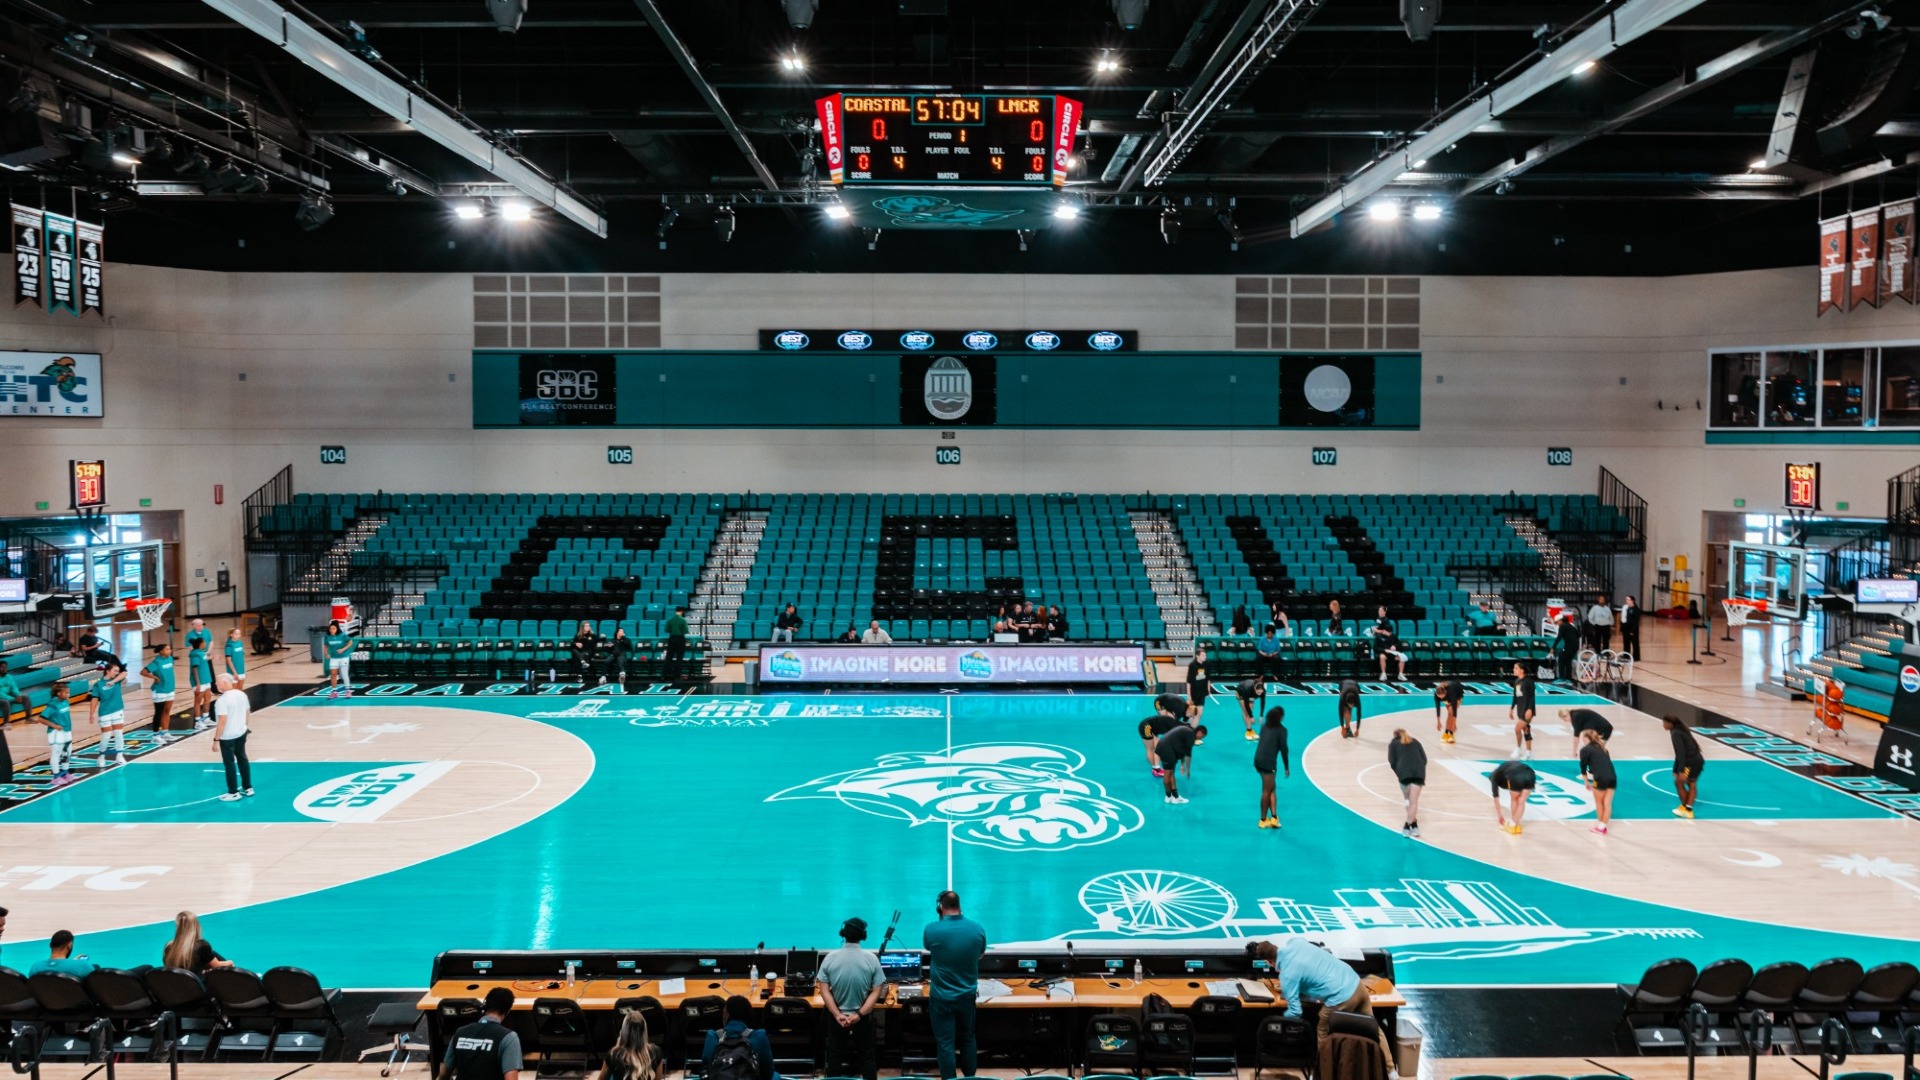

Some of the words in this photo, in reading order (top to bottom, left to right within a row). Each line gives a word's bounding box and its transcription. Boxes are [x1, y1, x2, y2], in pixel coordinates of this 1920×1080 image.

[844, 98, 911, 112] COASTAL
[917, 99, 980, 121] 57:04
[998, 99, 1039, 113] LMCR
[825, 100, 838, 145] CIRCLE
[1059, 102, 1073, 147] CIRCLE
[872, 119, 886, 140] 0
[928, 132, 953, 140] PERIOD
[960, 129, 967, 142] 1
[1030, 120, 1044, 141] 0
[850, 146, 871, 154] FOULS
[925, 147, 950, 155] PLAYER
[954, 147, 971, 155] FOUL
[858, 154, 869, 170] 0
[893, 156, 904, 169] 4
[991, 156, 1002, 170] 4
[1032, 155, 1043, 172] 0
[850, 171, 872, 180] SCORE
[937, 172, 960, 180] MATCH
[1024, 172, 1045, 181] SCORE
[17, 253, 39, 277] 23
[51, 258, 71, 281] 50
[82, 266, 101, 287] 25
[780, 334, 803, 342] BEST
[843, 334, 866, 342] BEST
[906, 334, 929, 342] BEST
[968, 334, 992, 342] BEST
[1031, 335, 1054, 343] BEST
[1093, 335, 1117, 343] BEST
[0, 374, 88, 403] HTC
[537, 370, 598, 400] SBC
[0, 406, 89, 414] ENTER
[321, 450, 345, 462] 104
[609, 450, 632, 462] 105
[937, 450, 960, 462] 106
[1313, 451, 1336, 463] 107
[1549, 451, 1571, 463] 108
[80, 479, 98, 501] 30
[1792, 480, 1811, 503] 30
[810, 656, 888, 672] IMAGINE
[894, 656, 947, 672] MORE
[1000, 656, 1079, 672] IMAGINE
[1084, 656, 1138, 672] MORE
[1209, 682, 1592, 694] CAROLNA
[456, 1037, 494, 1051] ESPN
